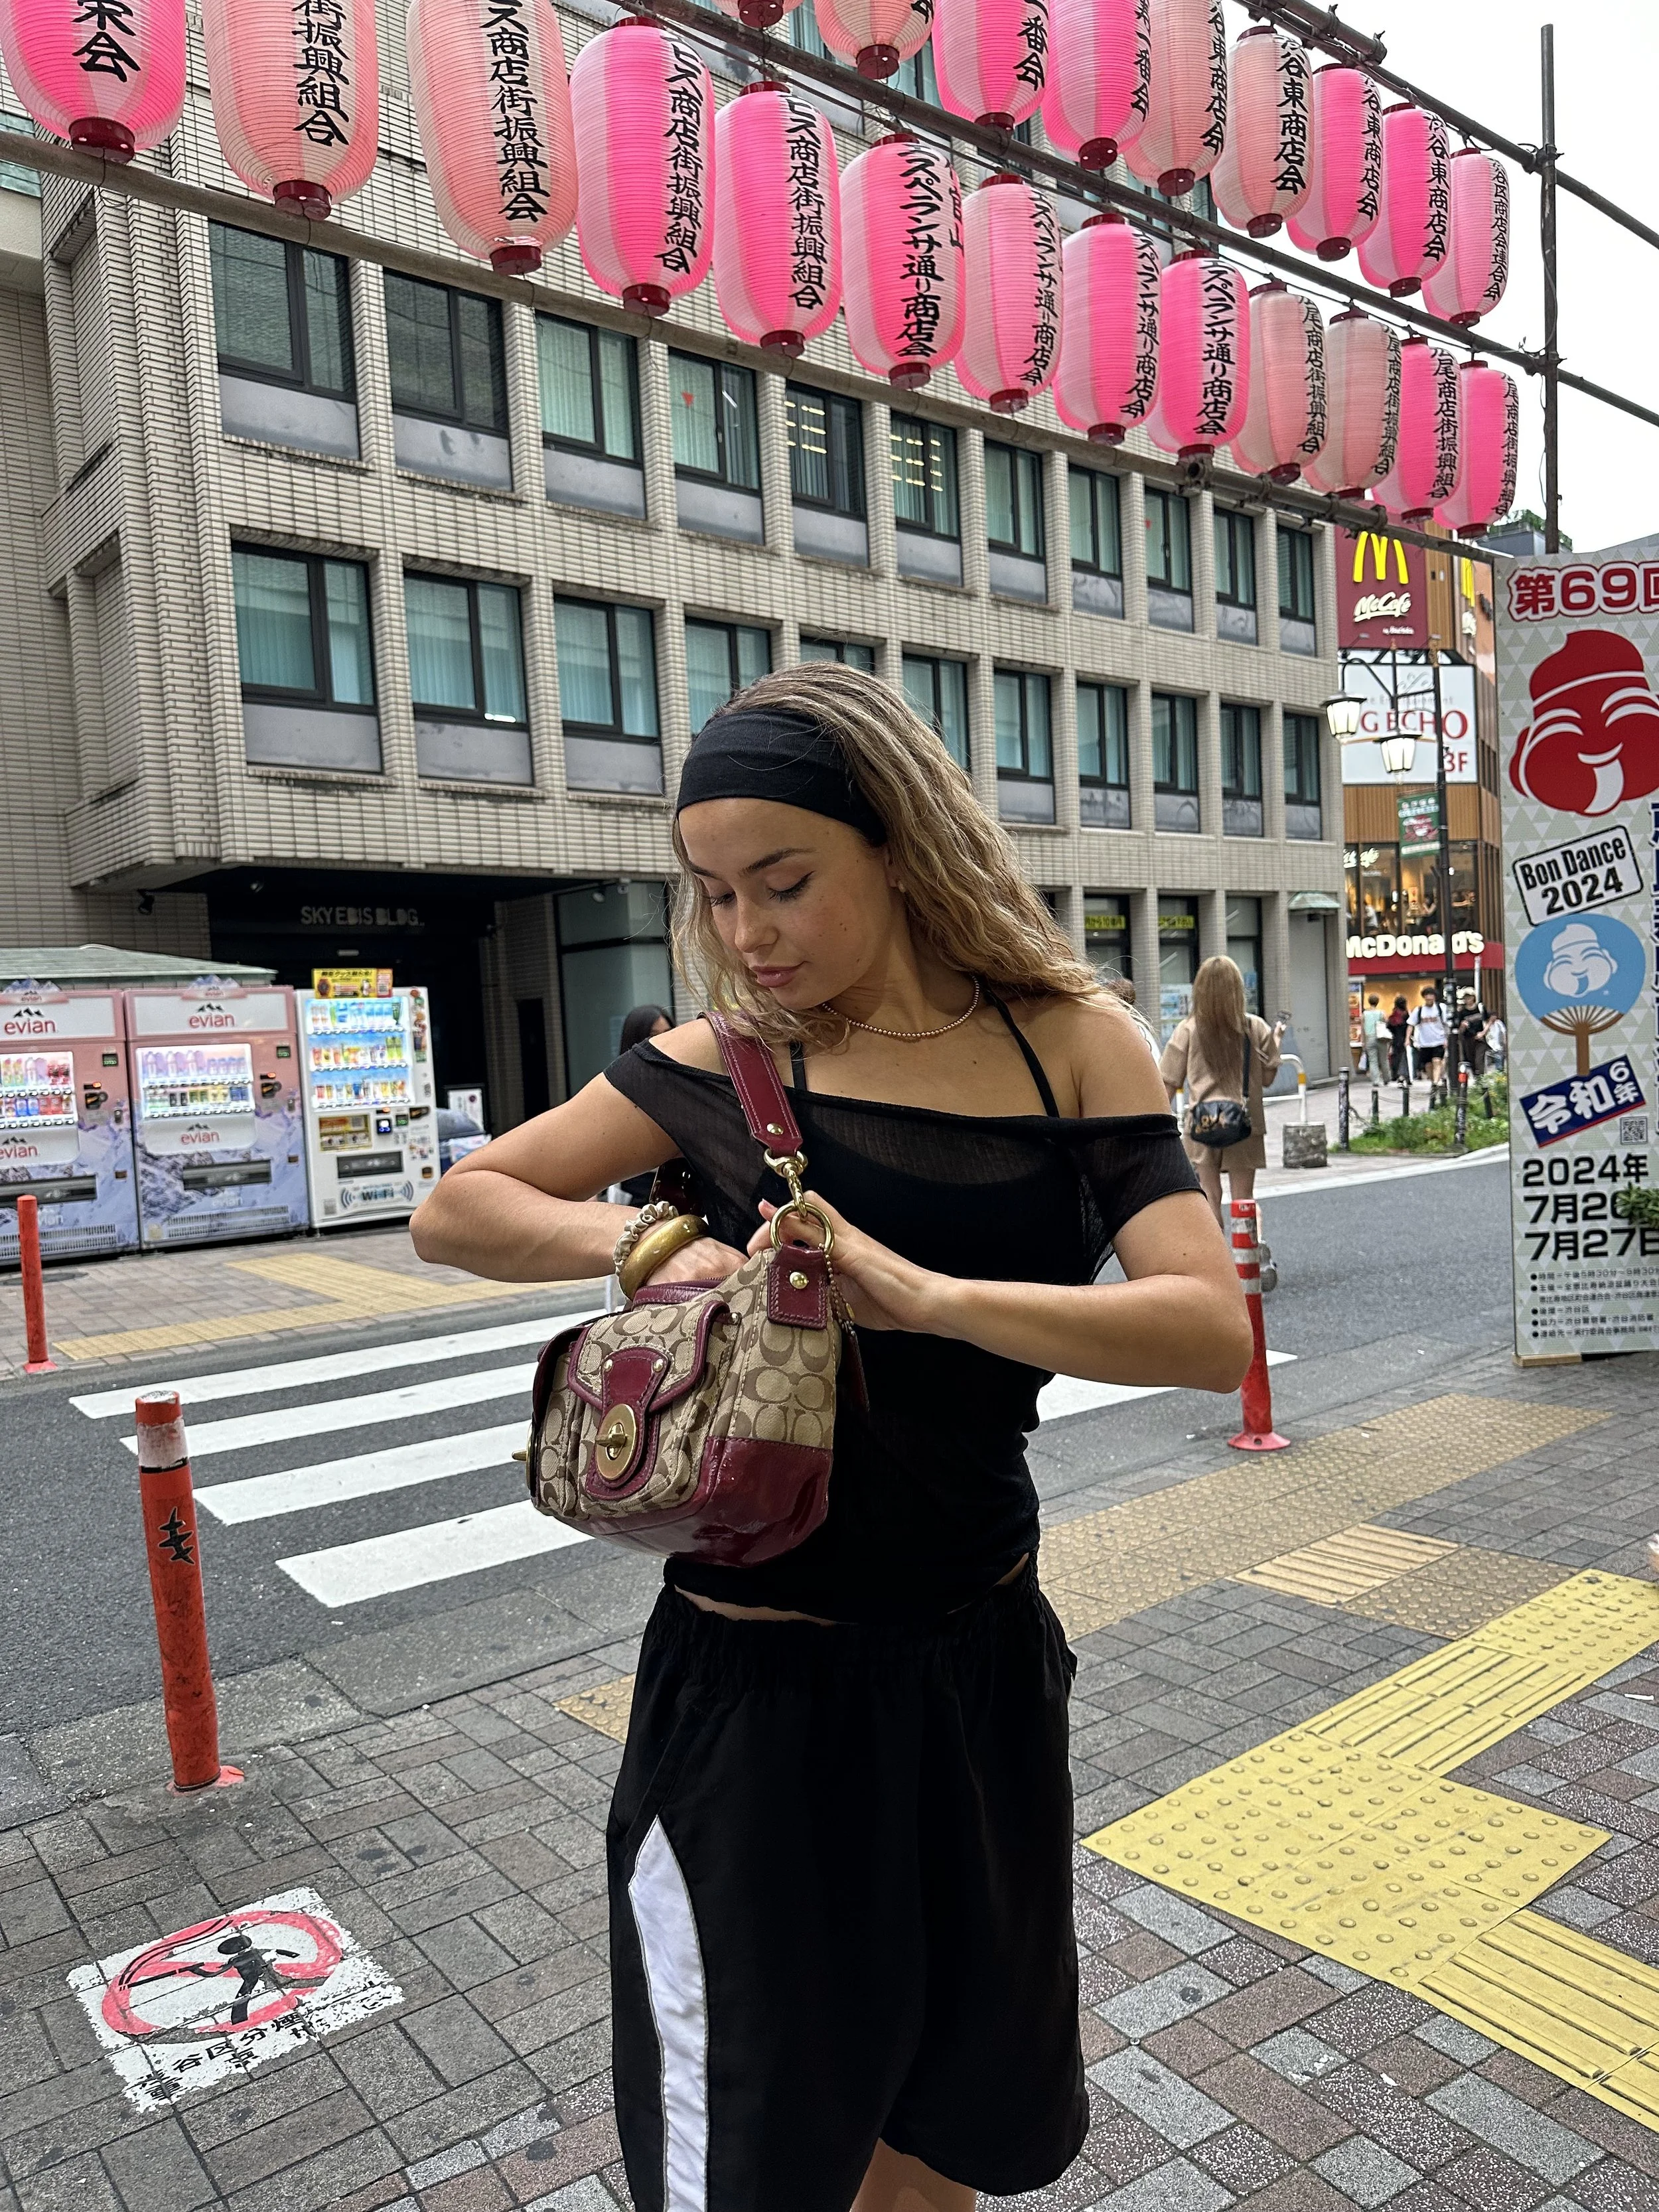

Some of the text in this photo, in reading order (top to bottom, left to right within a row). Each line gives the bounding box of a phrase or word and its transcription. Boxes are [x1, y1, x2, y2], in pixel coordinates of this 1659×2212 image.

[479, 0, 551, 222] ス商店街振興組会
[1520, 836, 1626, 891] Bon Dance
[1542, 866, 1624, 917] 2024
[1345, 931, 1484, 958] McDonad's
[4, 1017, 56, 1035] evian
[189, 1013, 235, 1028] evian
[180, 1130, 220, 1144] evian
[1523, 1153, 1648, 1187] 2024年
[38, 1211, 63, 1227] vian
[1525, 1228, 1659, 1260] 7月27日
